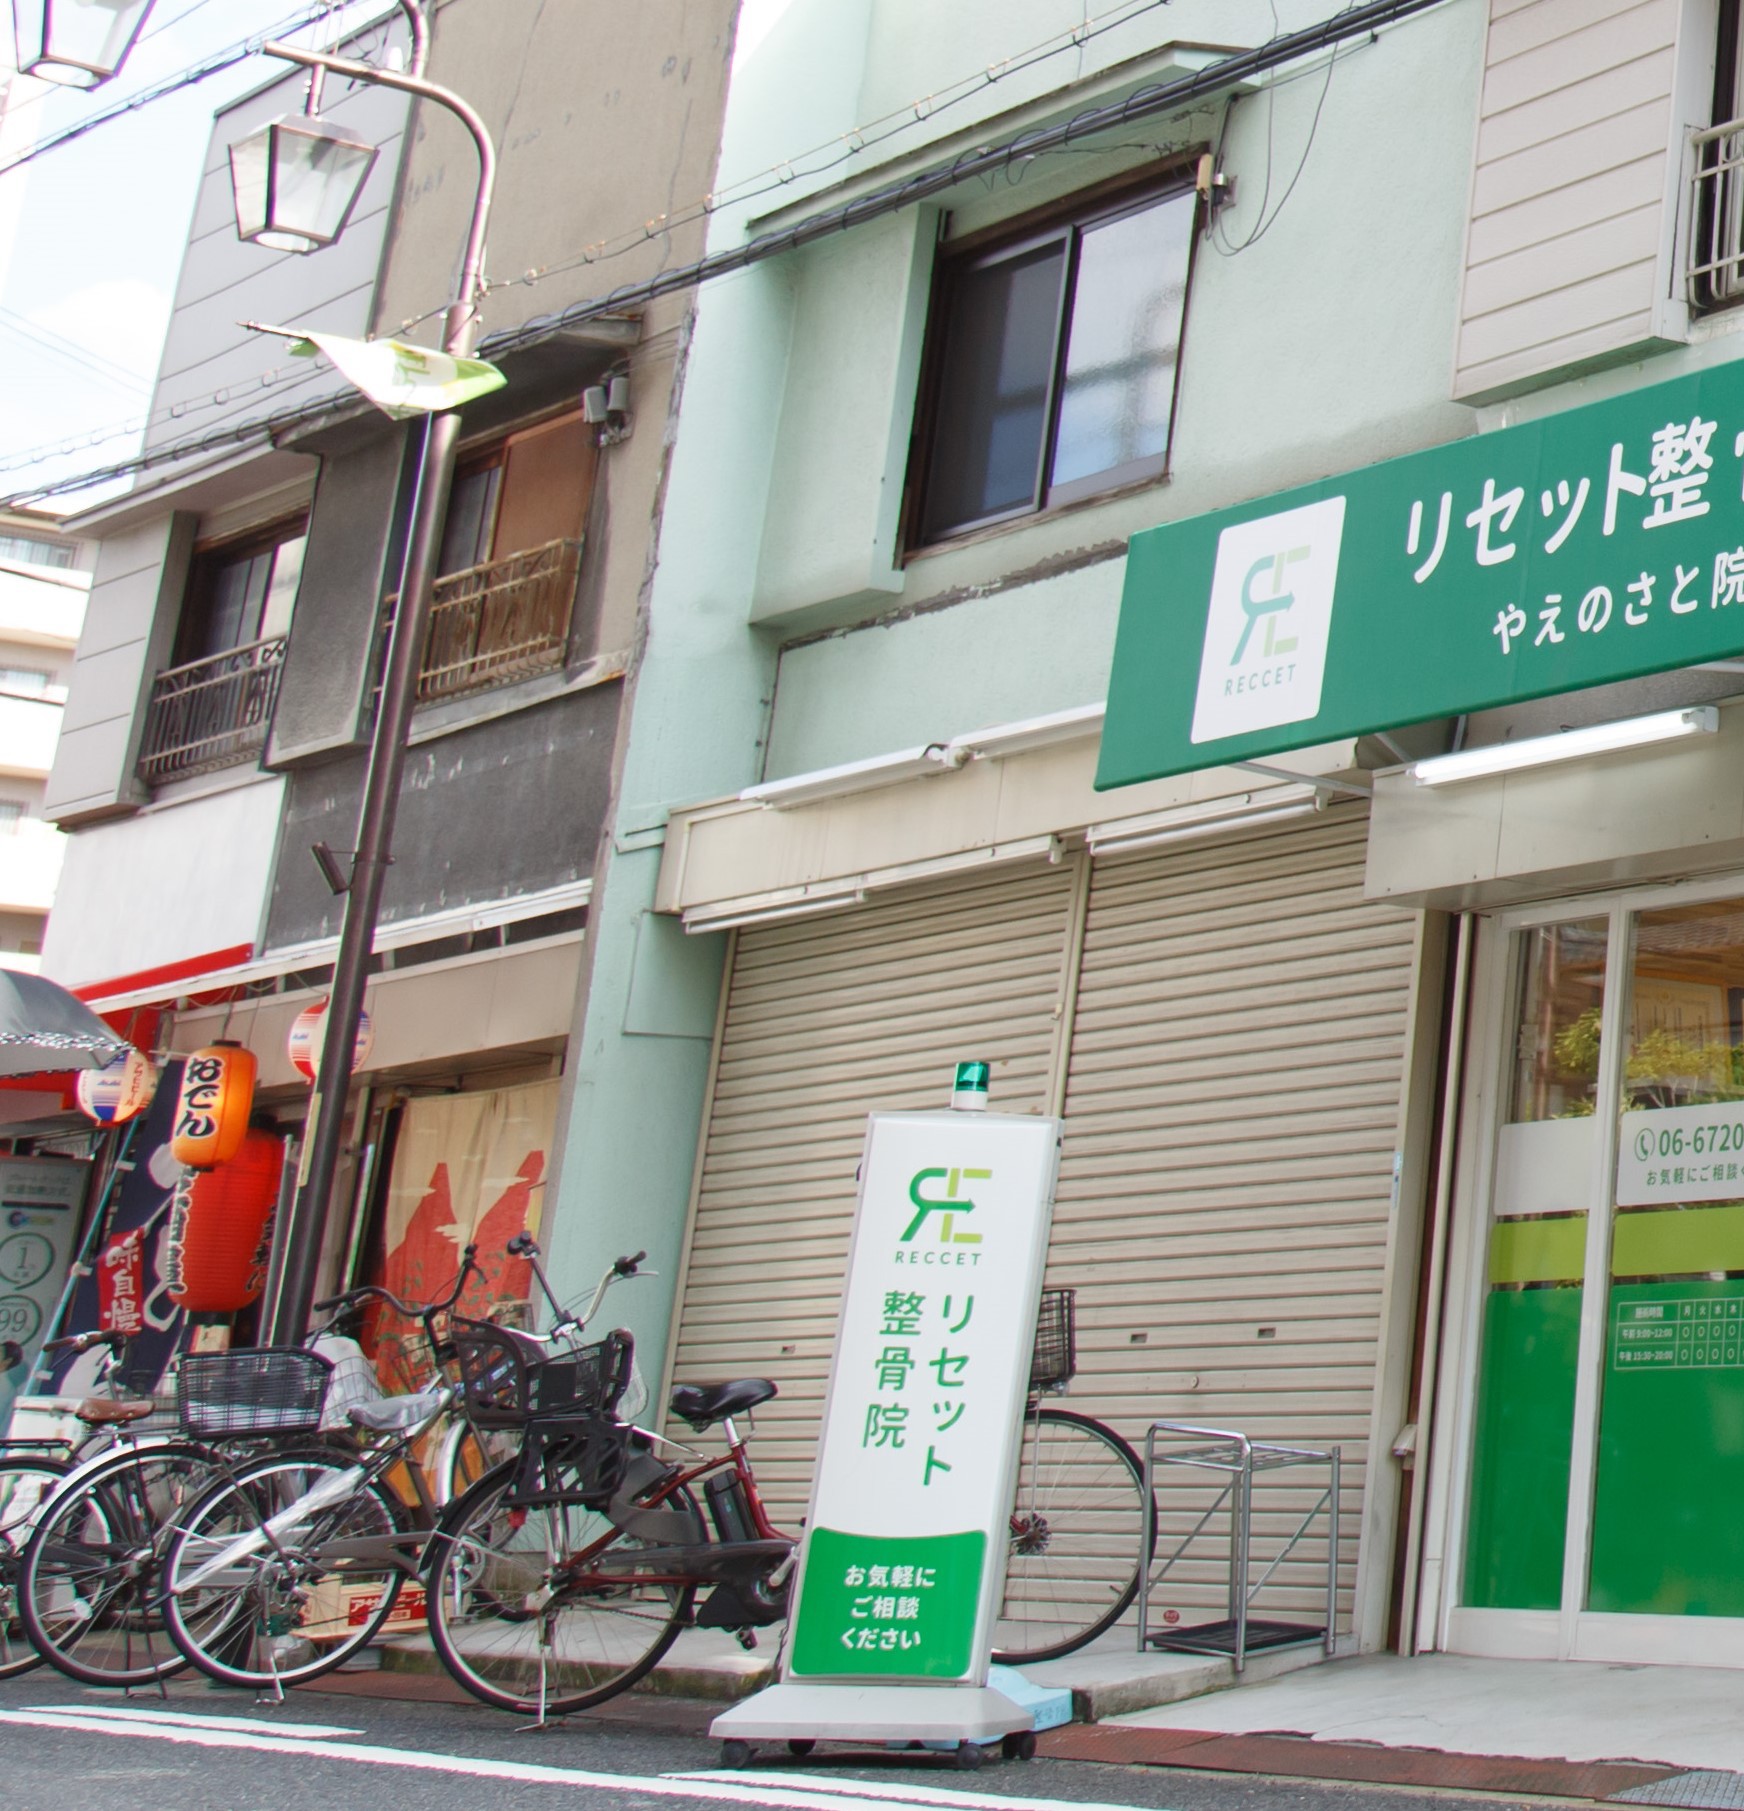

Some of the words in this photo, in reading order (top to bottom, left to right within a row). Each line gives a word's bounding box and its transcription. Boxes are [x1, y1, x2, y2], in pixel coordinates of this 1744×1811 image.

[1223, 663, 1298, 697] RECCET
[175, 1056, 224, 1138] おでん
[895, 1250, 981, 1266] RECCET
[862, 1290, 925, 1450] 整骨院
[920, 1294, 975, 1487] リセット
[845, 1565, 935, 1589] お気軽に
[850, 1596, 919, 1620] ご相談
[840, 1628, 922, 1651] ください
